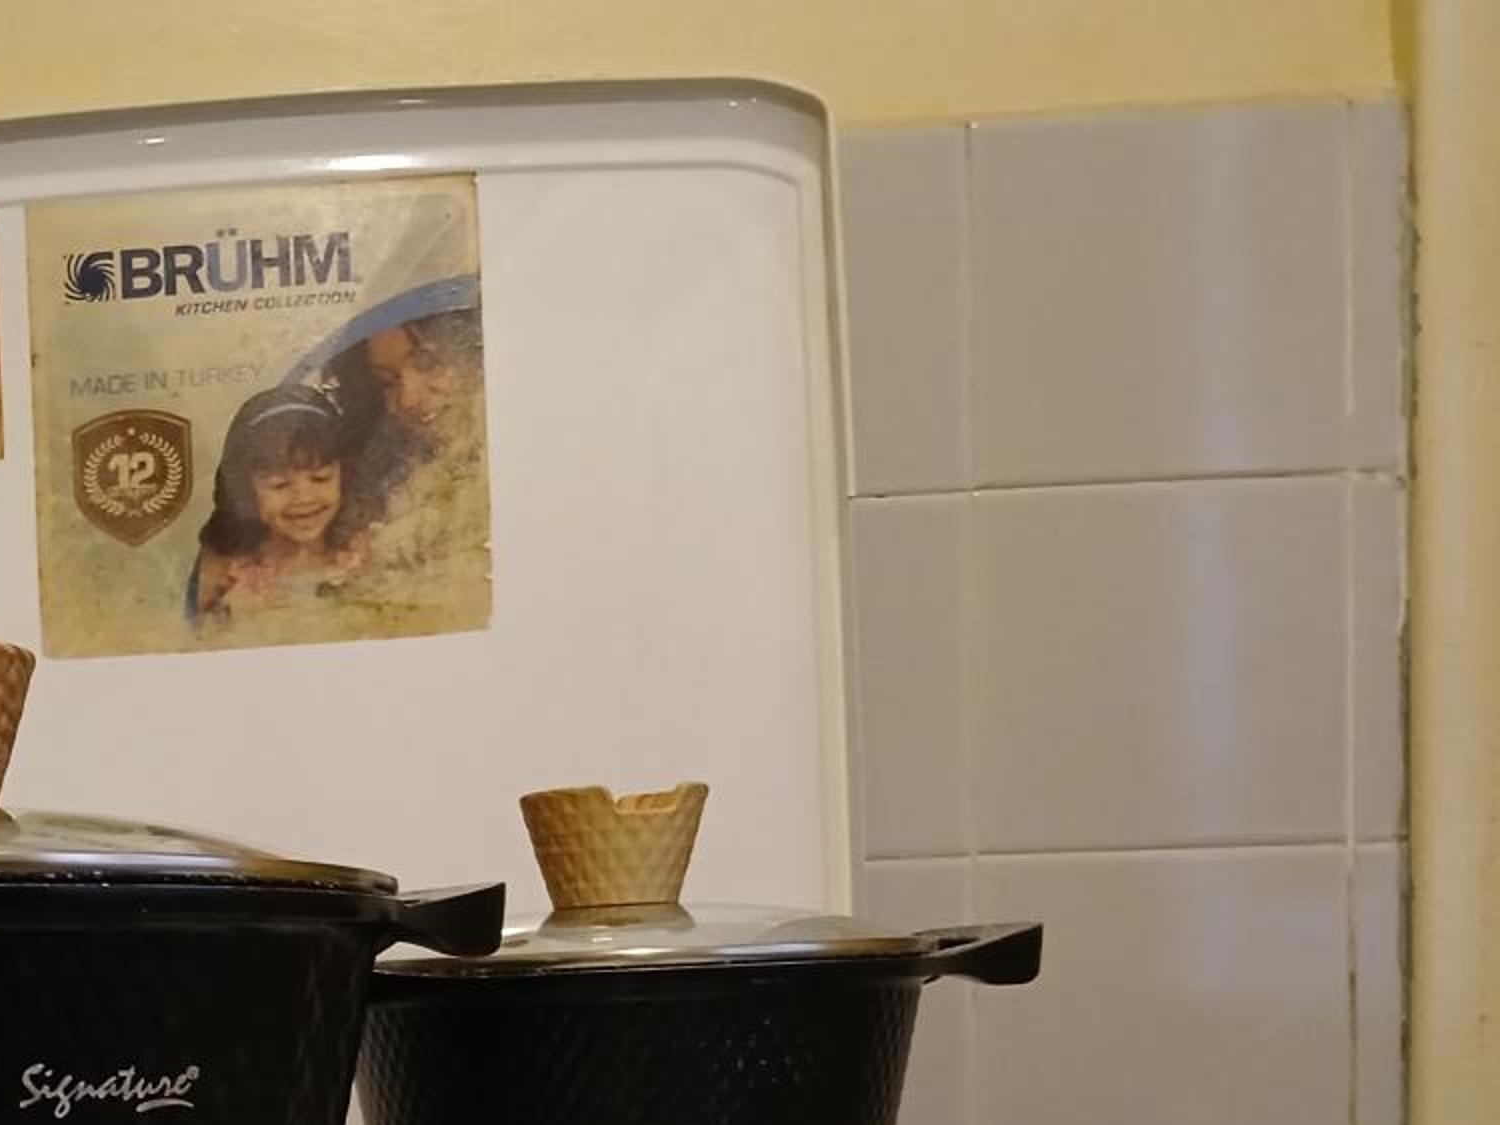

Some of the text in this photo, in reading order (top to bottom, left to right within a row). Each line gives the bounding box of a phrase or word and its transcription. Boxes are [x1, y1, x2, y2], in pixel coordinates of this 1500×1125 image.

[118, 227, 351, 298] BRÜHM
[174, 300, 248, 317] KITCHEN
[70, 373, 137, 397] MADE
[144, 370, 169, 391] IN
[107, 451, 157, 490] 12
[19, 1063, 194, 1119] Signature
